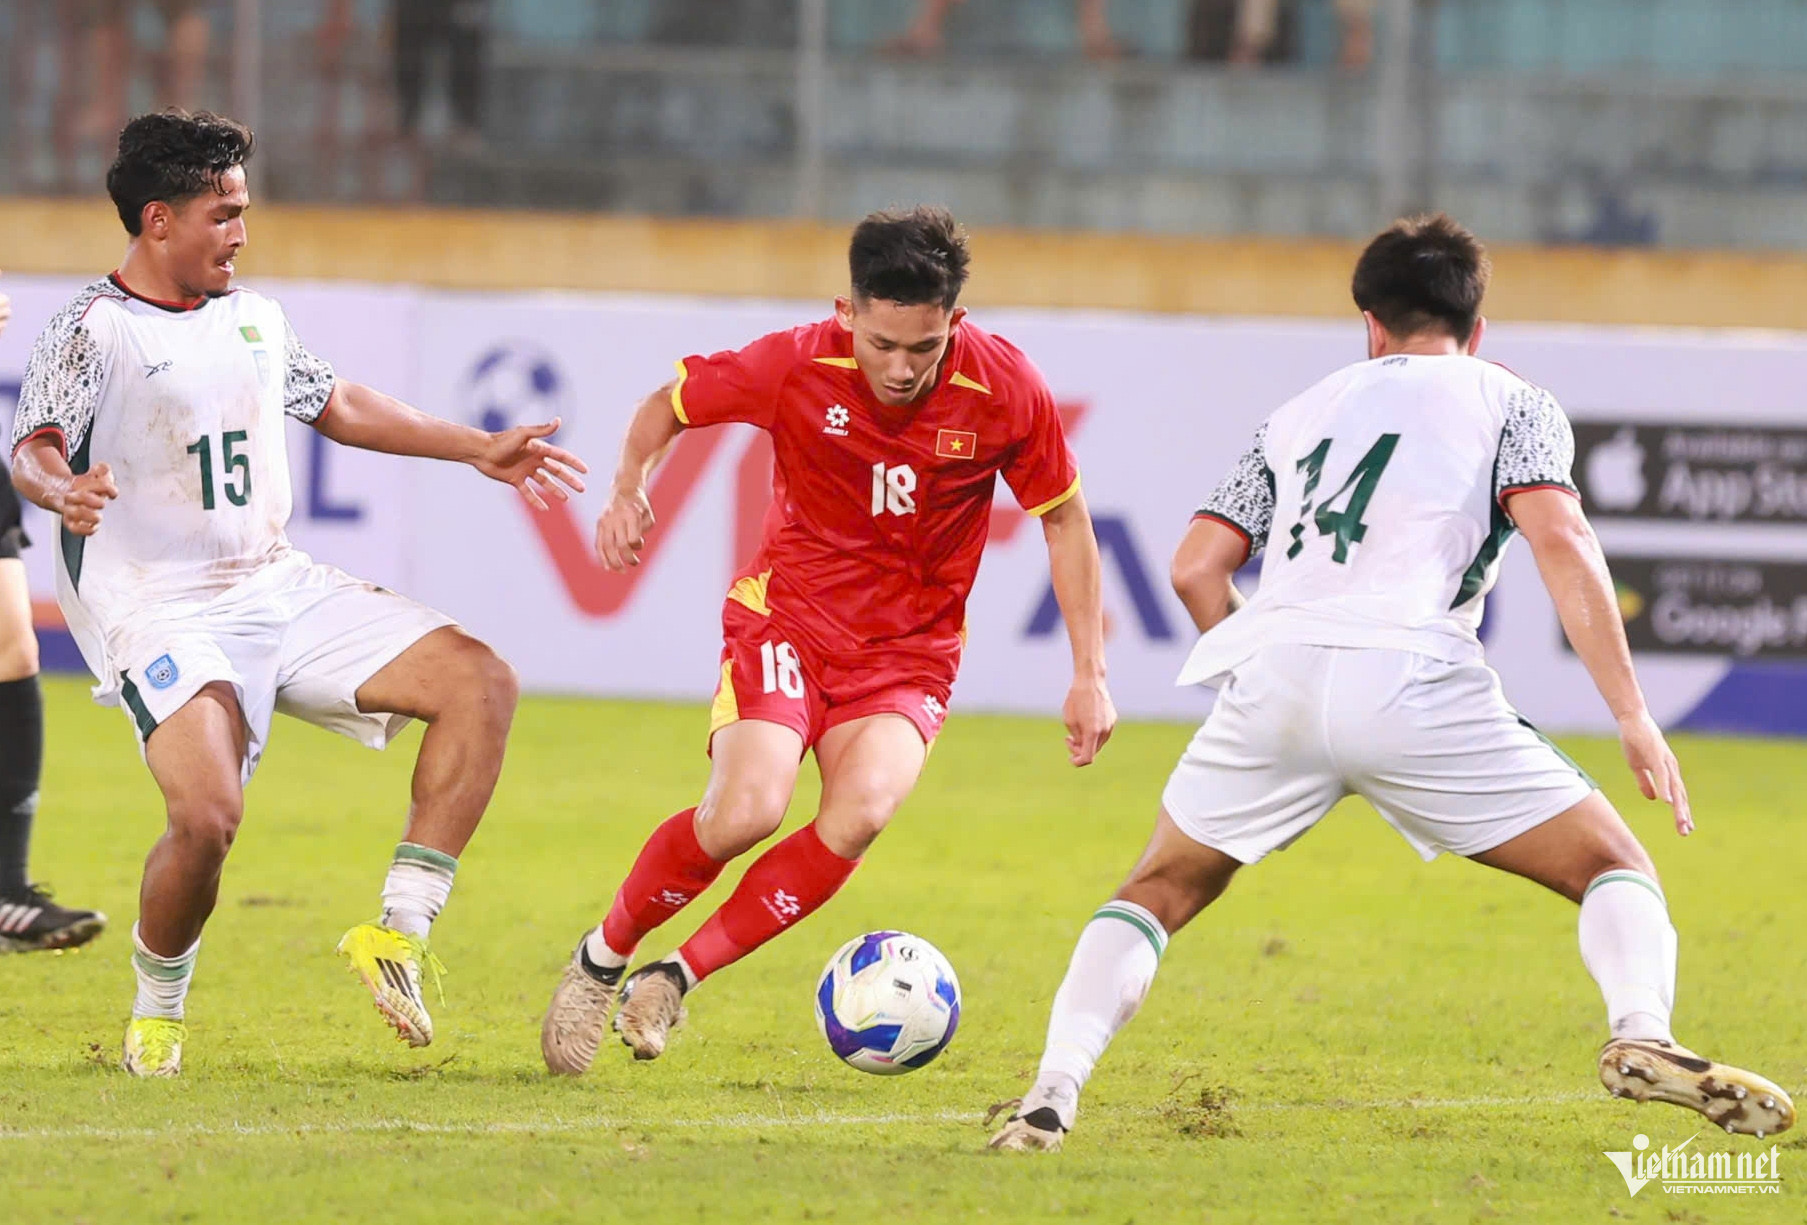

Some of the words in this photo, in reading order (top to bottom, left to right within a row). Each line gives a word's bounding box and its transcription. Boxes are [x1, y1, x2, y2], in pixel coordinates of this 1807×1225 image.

[187, 430, 252, 510] 15
[872, 462, 917, 517] 18
[1287, 433, 1401, 564] 14
[1659, 462, 1750, 521] App
[1652, 593, 1788, 654] Google
[760, 639, 804, 699] 18
